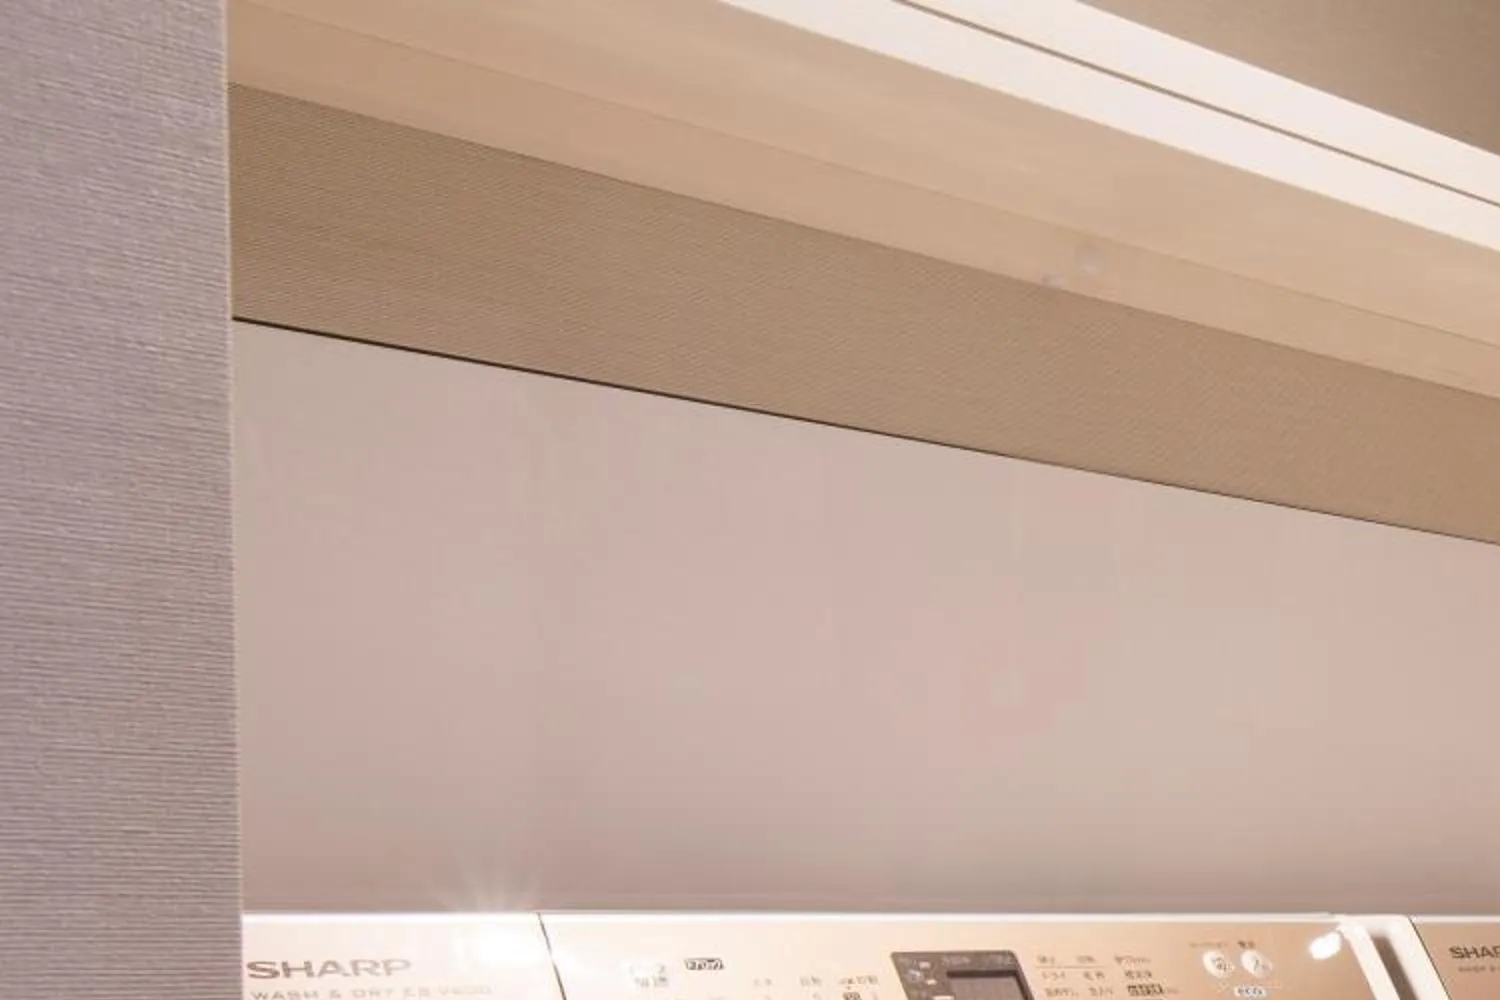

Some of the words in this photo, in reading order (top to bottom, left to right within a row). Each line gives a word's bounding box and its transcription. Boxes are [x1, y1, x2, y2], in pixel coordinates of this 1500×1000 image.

[246, 959, 411, 979] SHARP
[250, 989, 320, 1000] WASH
[329, 989, 343, 999] &
[352, 987, 394, 999] DRY
